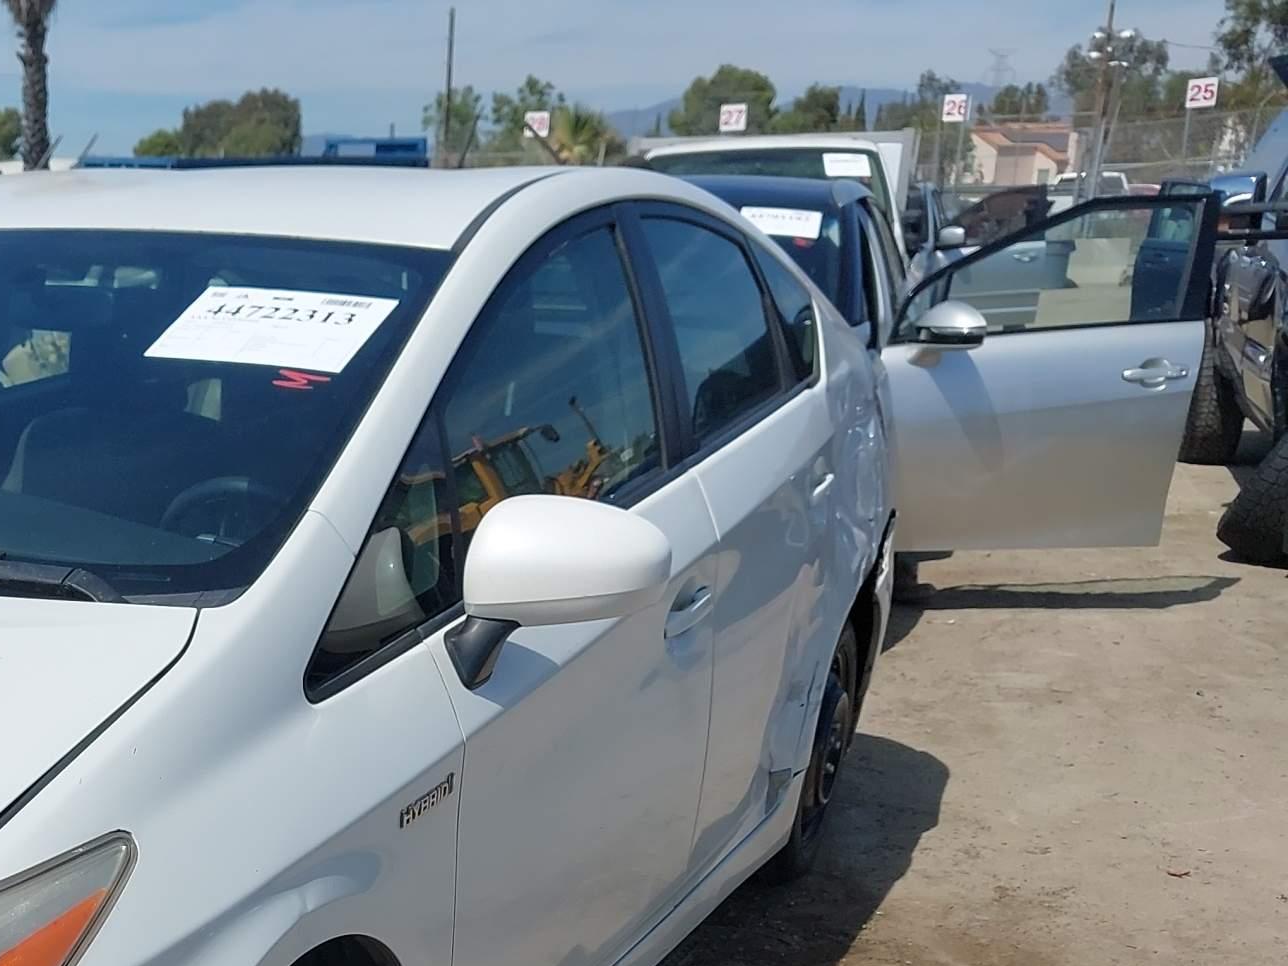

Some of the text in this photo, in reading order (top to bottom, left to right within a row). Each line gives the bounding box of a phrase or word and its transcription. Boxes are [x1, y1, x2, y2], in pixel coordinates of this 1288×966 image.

[1189, 83, 1216, 101] 25
[721, 108, 744, 126] 27
[207, 303, 357, 325] 44722313
[400, 772, 454, 829] HYBRID
